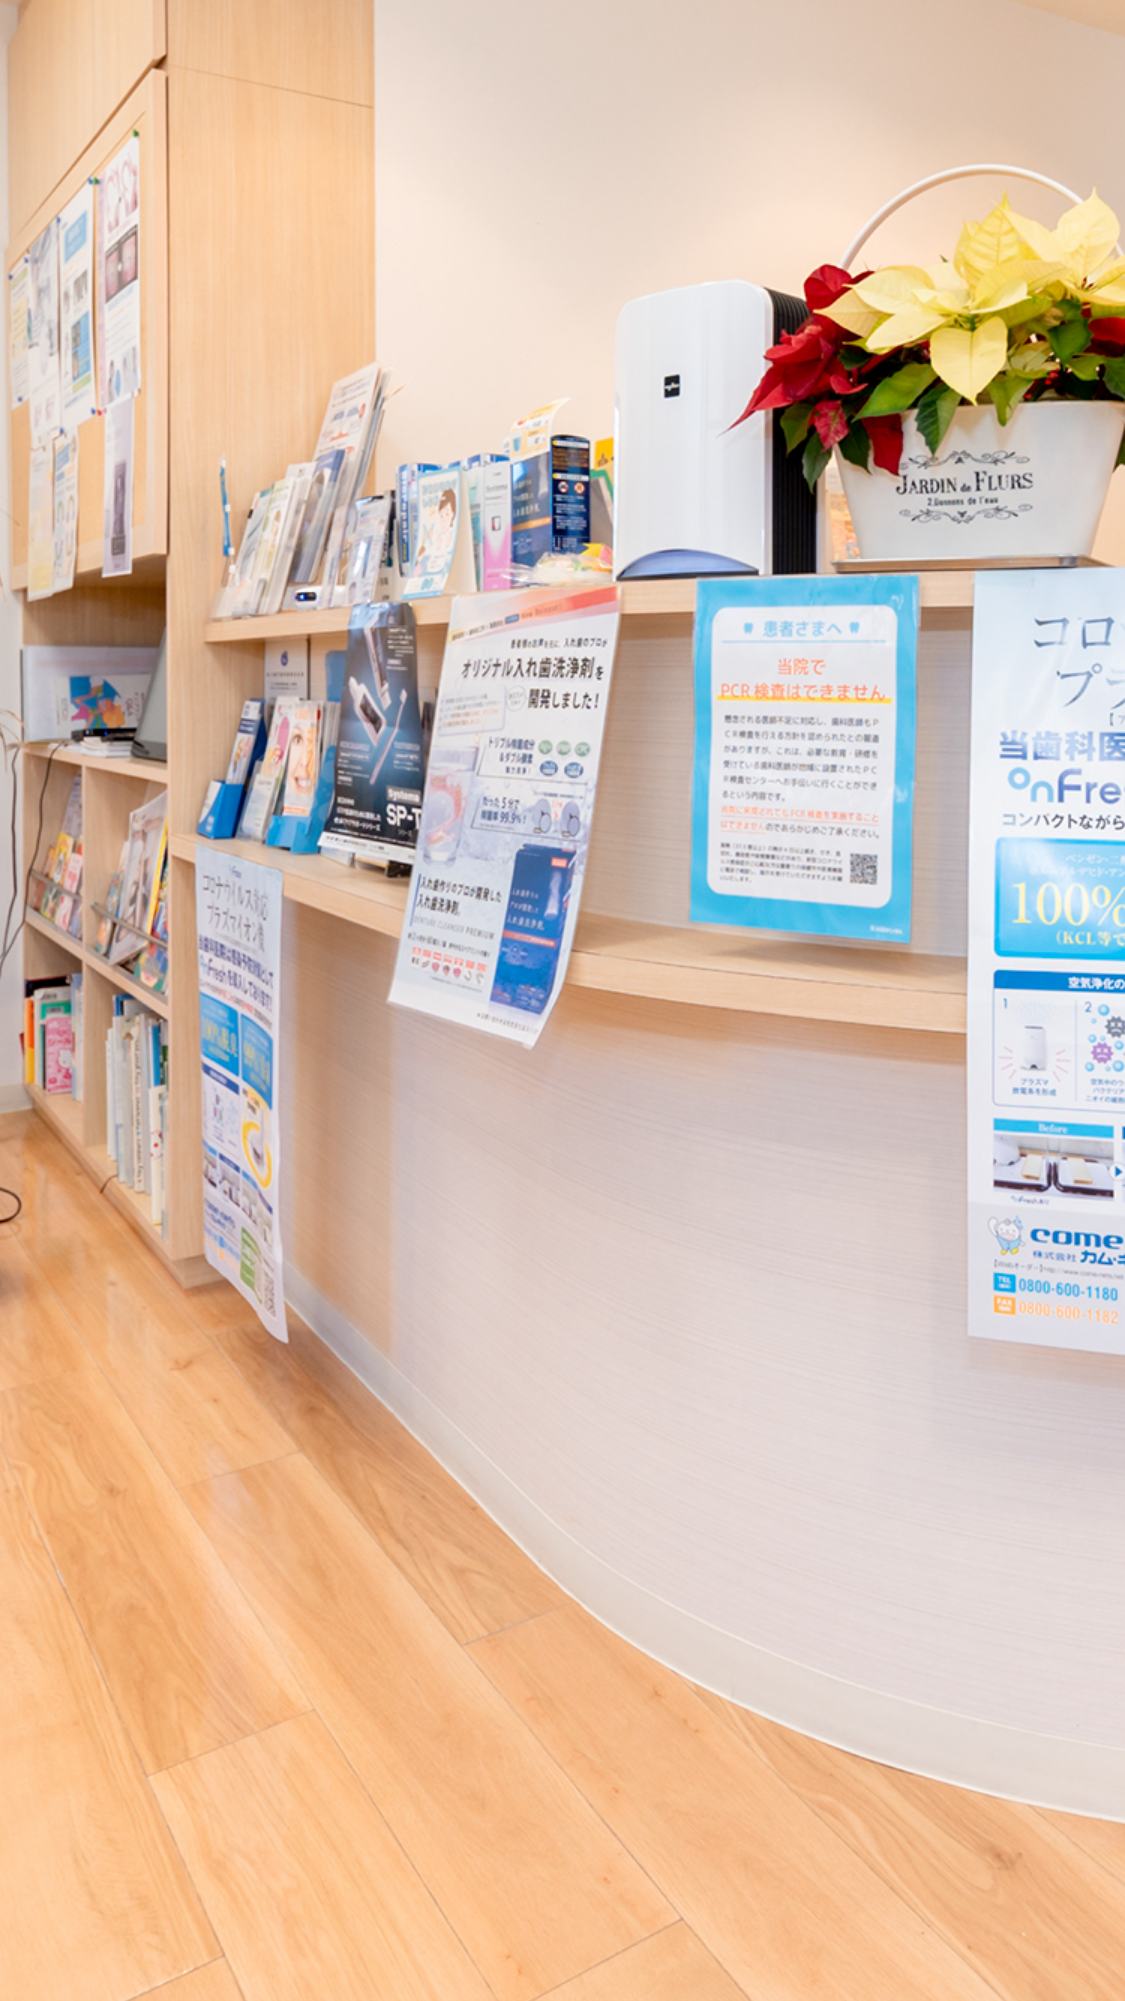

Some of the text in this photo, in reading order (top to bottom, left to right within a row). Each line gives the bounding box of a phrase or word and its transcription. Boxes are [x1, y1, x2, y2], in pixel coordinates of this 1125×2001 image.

[896, 470, 1033, 495] JARDIN de FLURS
[763, 620, 843, 638] 患者さまへ
[1034, 616, 1125, 650] コロ
[461, 656, 604, 681] オリジナル入れ歯洗浄剤を
[777, 658, 827, 676] 当院で
[720, 683, 886, 702] PCR 検査はできません
[1002, 812, 1125, 831] コンパクトながら
[1011, 881, 1125, 928] 100%
[1085, 1002, 1092, 1013] 2
[1018, 1278, 1118, 1302] 0800-600-1180
